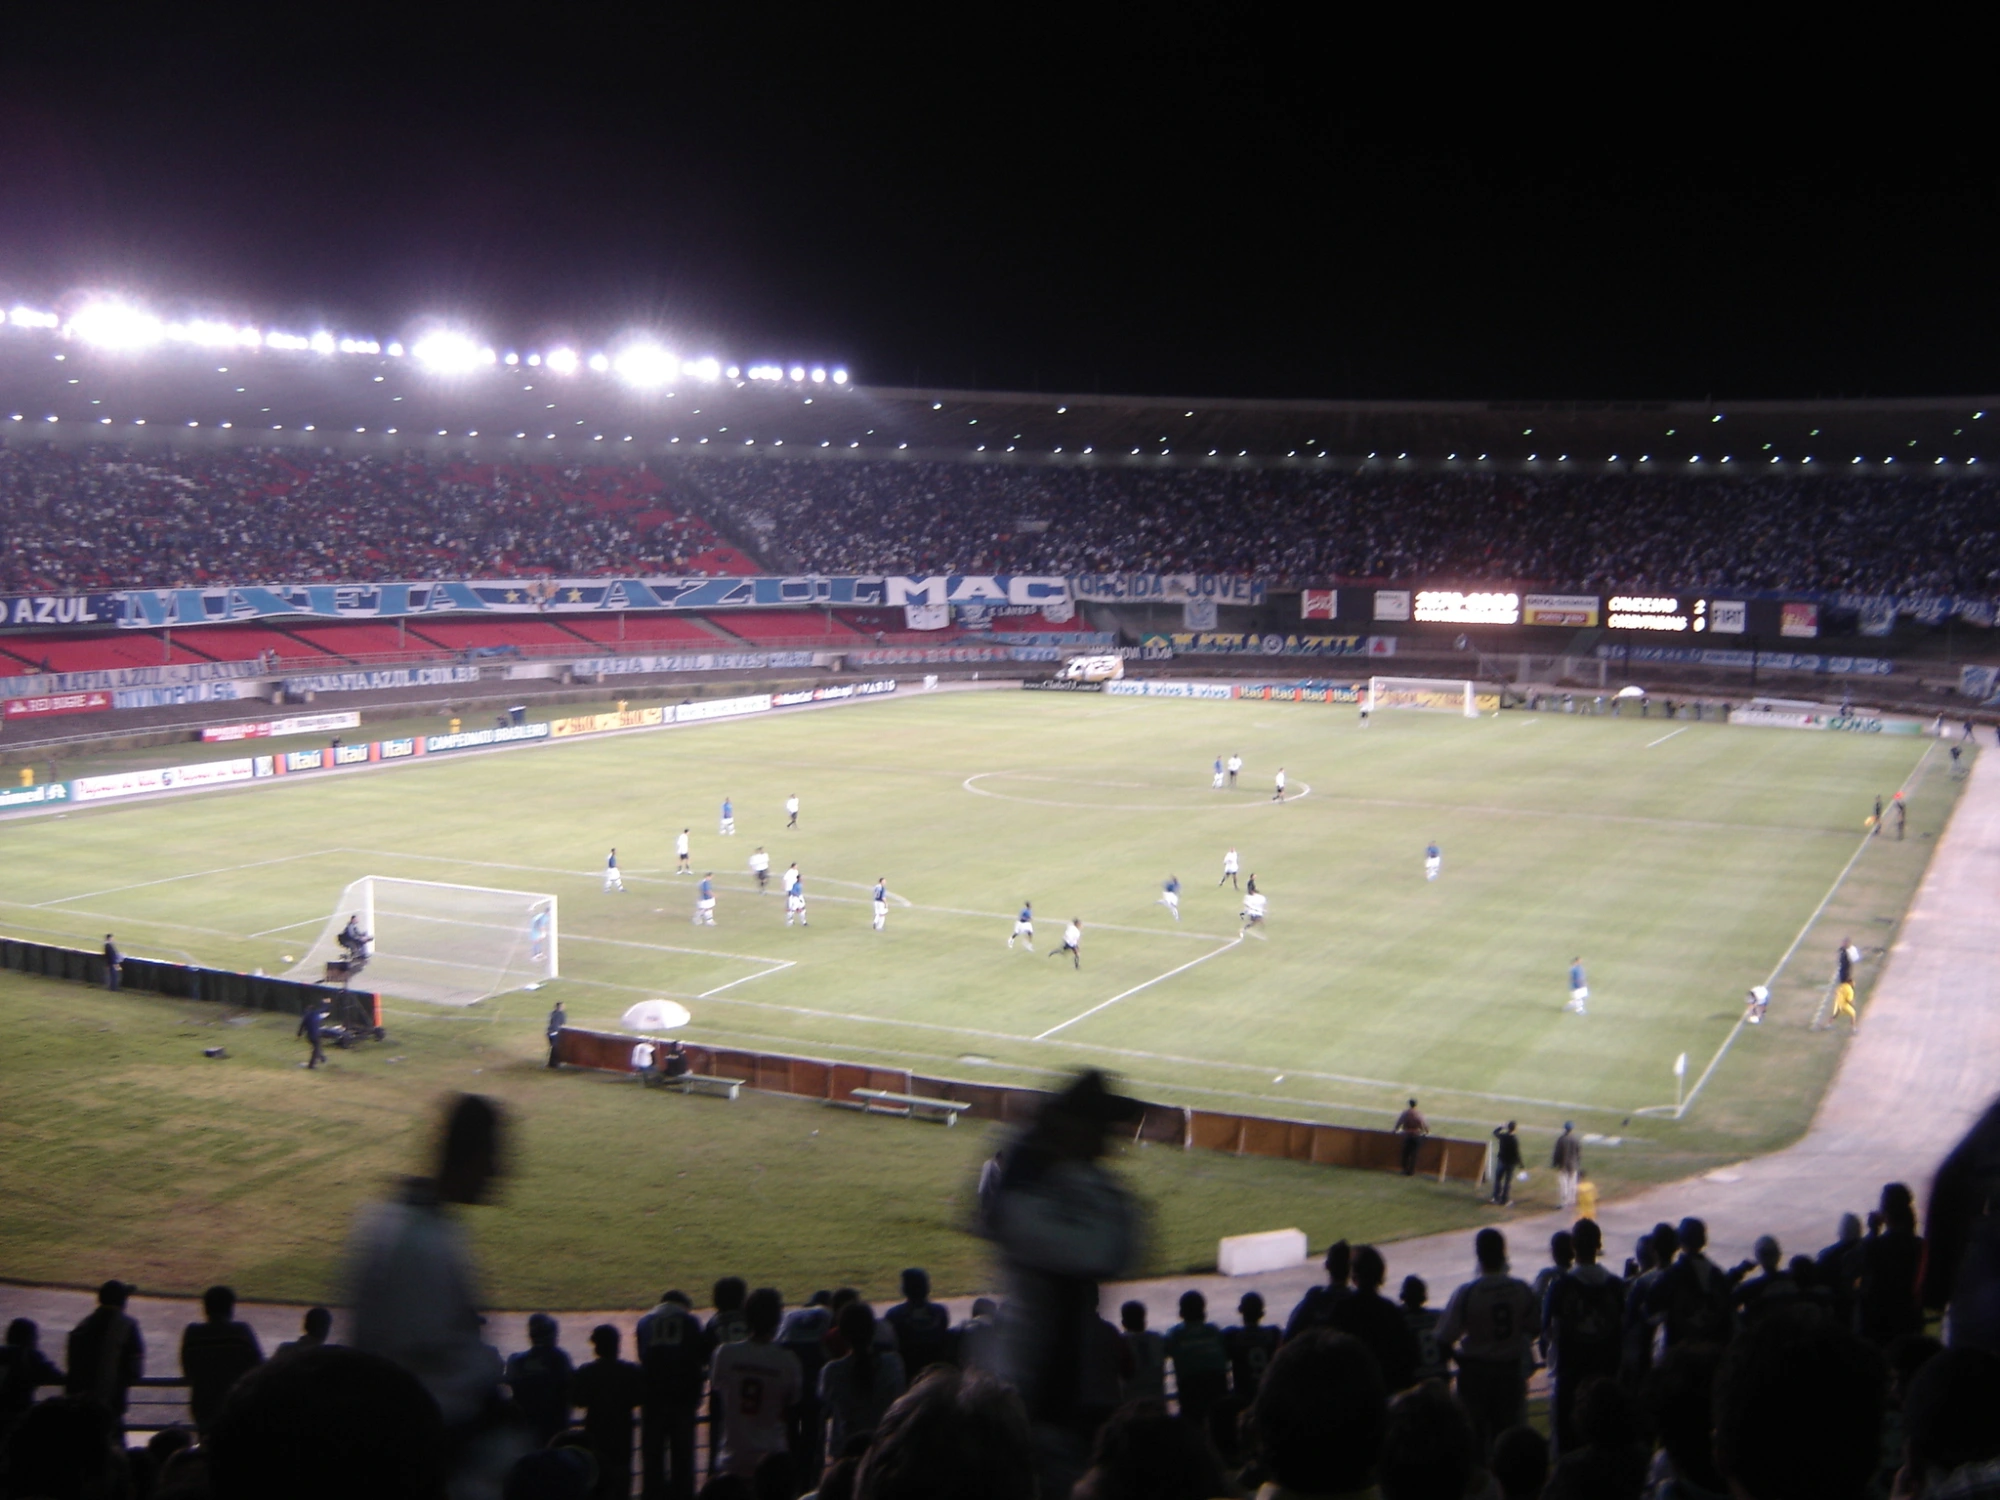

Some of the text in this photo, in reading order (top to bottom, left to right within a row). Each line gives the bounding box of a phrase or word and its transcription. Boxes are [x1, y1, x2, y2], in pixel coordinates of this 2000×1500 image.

[885, 576, 1070, 606] MAC
[13, 596, 98, 624] AZUL
[1694, 600, 1706, 614] 2
[1714, 608, 1744, 624] FIAT
[428, 722, 548, 752] CAMPEONATO BRASILEIRO
[336, 744, 368, 765] Itaú
[383, 738, 414, 759] Itaú
[289, 750, 322, 772] Itaú
